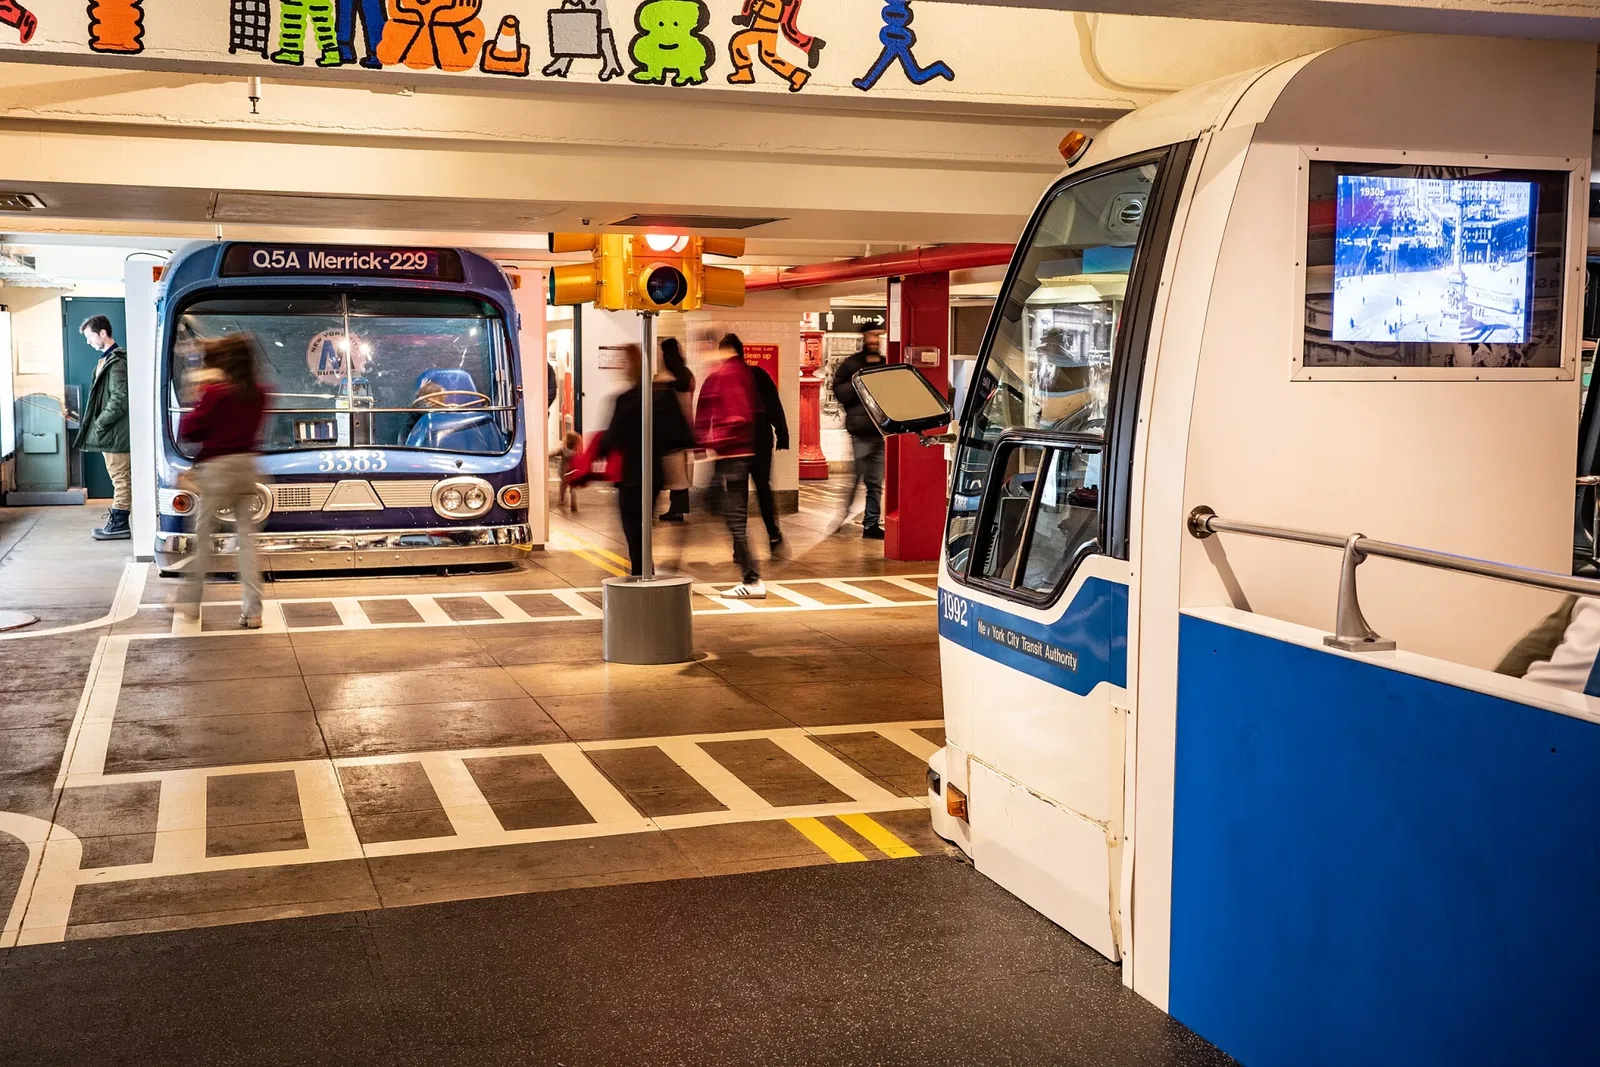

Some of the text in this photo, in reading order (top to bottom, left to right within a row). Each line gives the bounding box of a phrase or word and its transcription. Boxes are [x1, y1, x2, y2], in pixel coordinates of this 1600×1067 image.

[1360, 187, 1385, 197] 1930s
[252, 249, 428, 270] Q5A Merrick-229
[852, 314, 873, 324] Men
[311, 336, 322, 353] NEW
[318, 450, 388, 472] 3383
[943, 592, 968, 627] 1992
[992, 625, 1005, 642] York
[1007, 631, 1020, 648] City
[1021, 637, 1043, 656] Transit
[1044, 645, 1078, 671] Authority
